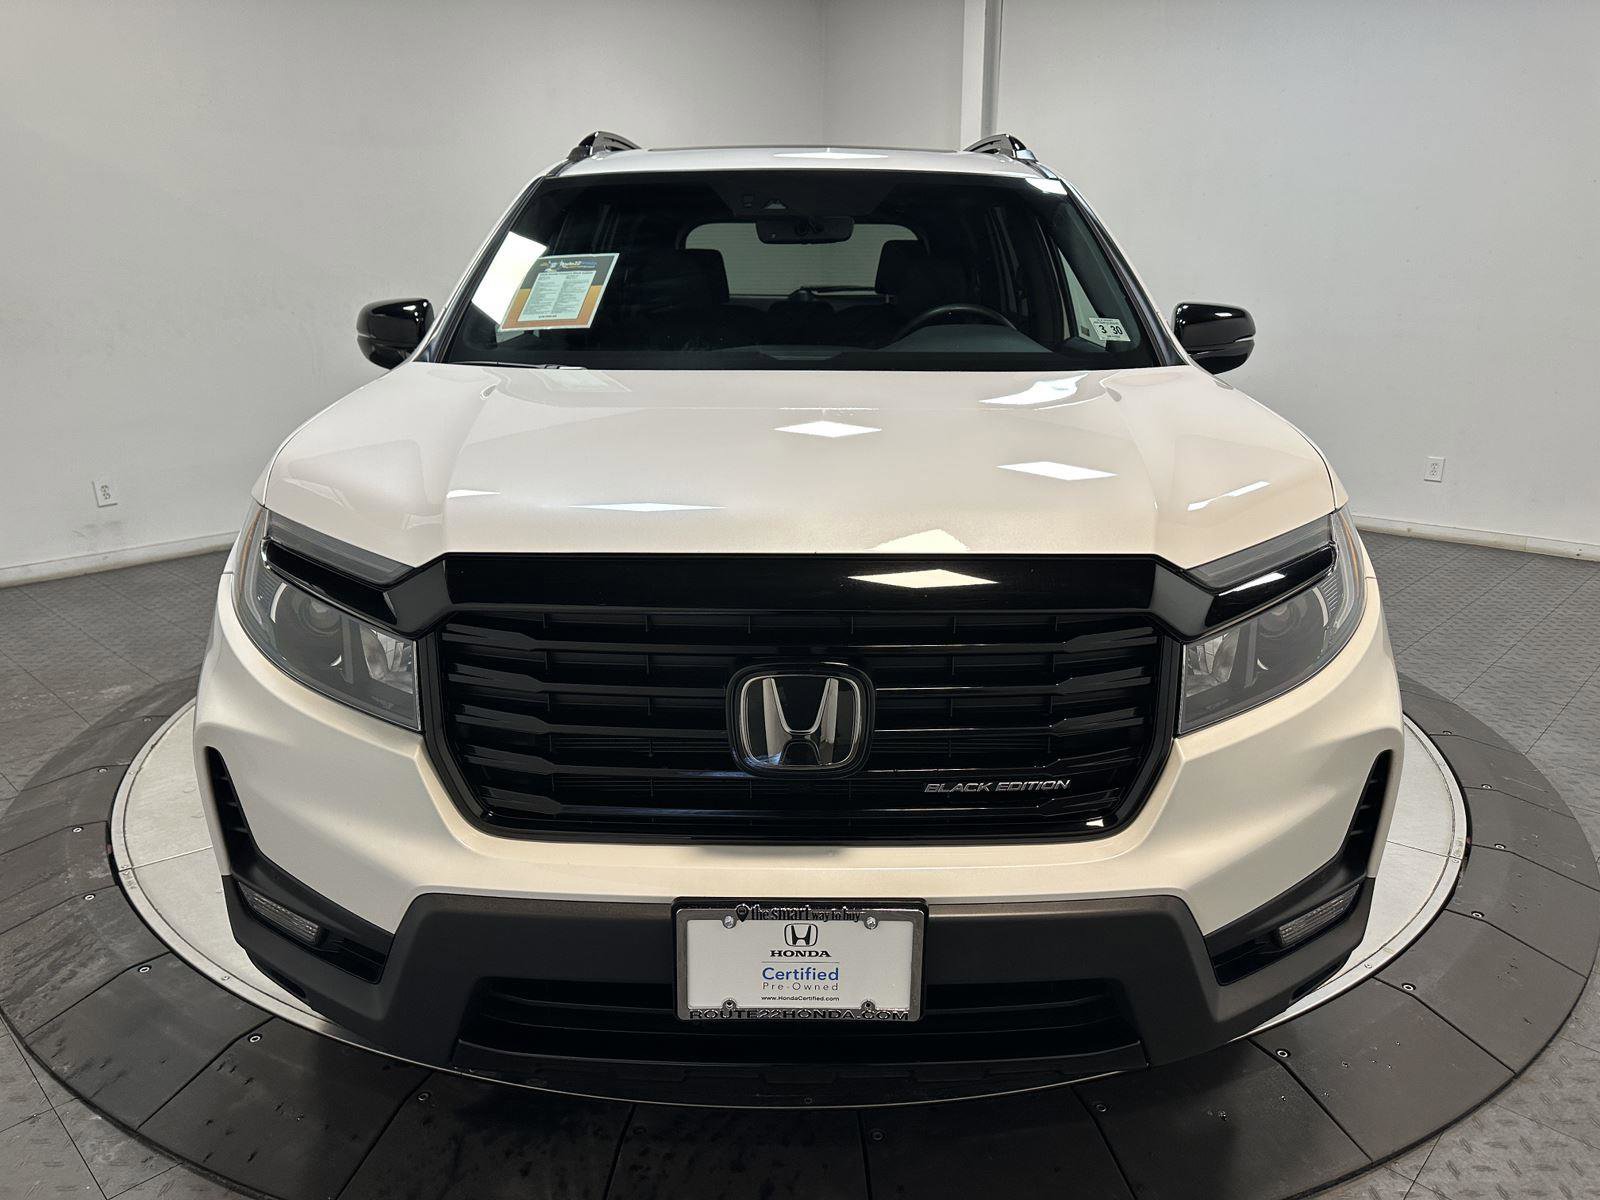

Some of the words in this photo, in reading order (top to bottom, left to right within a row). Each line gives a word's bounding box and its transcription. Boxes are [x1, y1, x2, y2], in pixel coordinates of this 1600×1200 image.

[1099, 325, 1107, 334] 3
[1110, 325, 1123, 335] 30
[924, 783, 993, 793] BLACK
[995, 780, 1070, 791] EDITION
[751, 904, 769, 921] the
[771, 906, 811, 921] smart
[812, 911, 829, 923] way
[831, 907, 841, 921] to
[842, 907, 860, 923] buy
[762, 967, 839, 980] Certified
[762, 982, 838, 990] Pre-Owned
[690, 1008, 909, 1021] ROUTE22HONDA.COM
